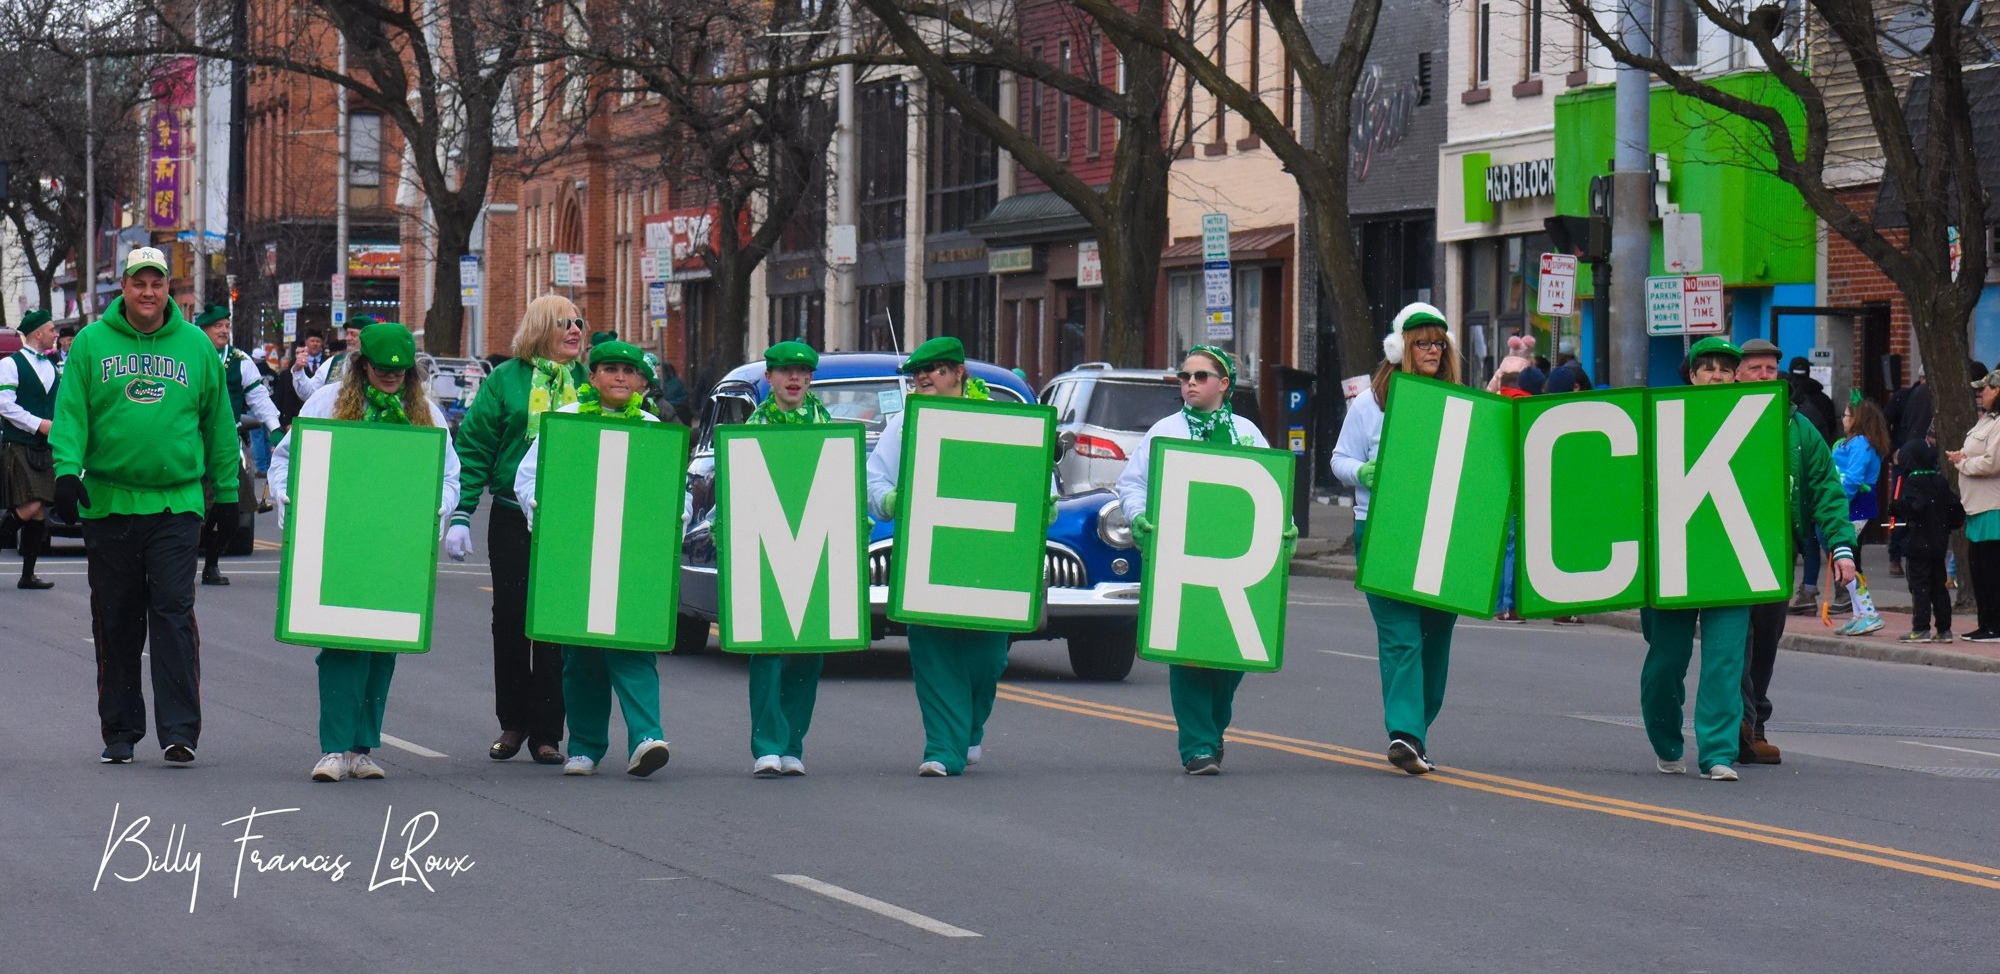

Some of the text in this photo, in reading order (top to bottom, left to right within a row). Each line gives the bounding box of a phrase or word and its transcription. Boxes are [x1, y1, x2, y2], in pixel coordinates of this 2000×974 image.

[1486, 158, 1556, 202] H&R BLOCK
[1542, 258, 1552, 270] NO
[1549, 280, 1565, 289] ANY
[1654, 281, 1677, 290] METER
[1685, 278, 1697, 291] NO
[1547, 289, 1565, 299] TIME
[1650, 292, 1681, 300] PARKING
[1694, 296, 1711, 305] ANY
[1653, 303, 1680, 311] 8AM-6PM
[1654, 313, 1679, 321] MON-FRI
[1692, 307, 1714, 318] TIME
[101, 354, 189, 387] FLORIDA
